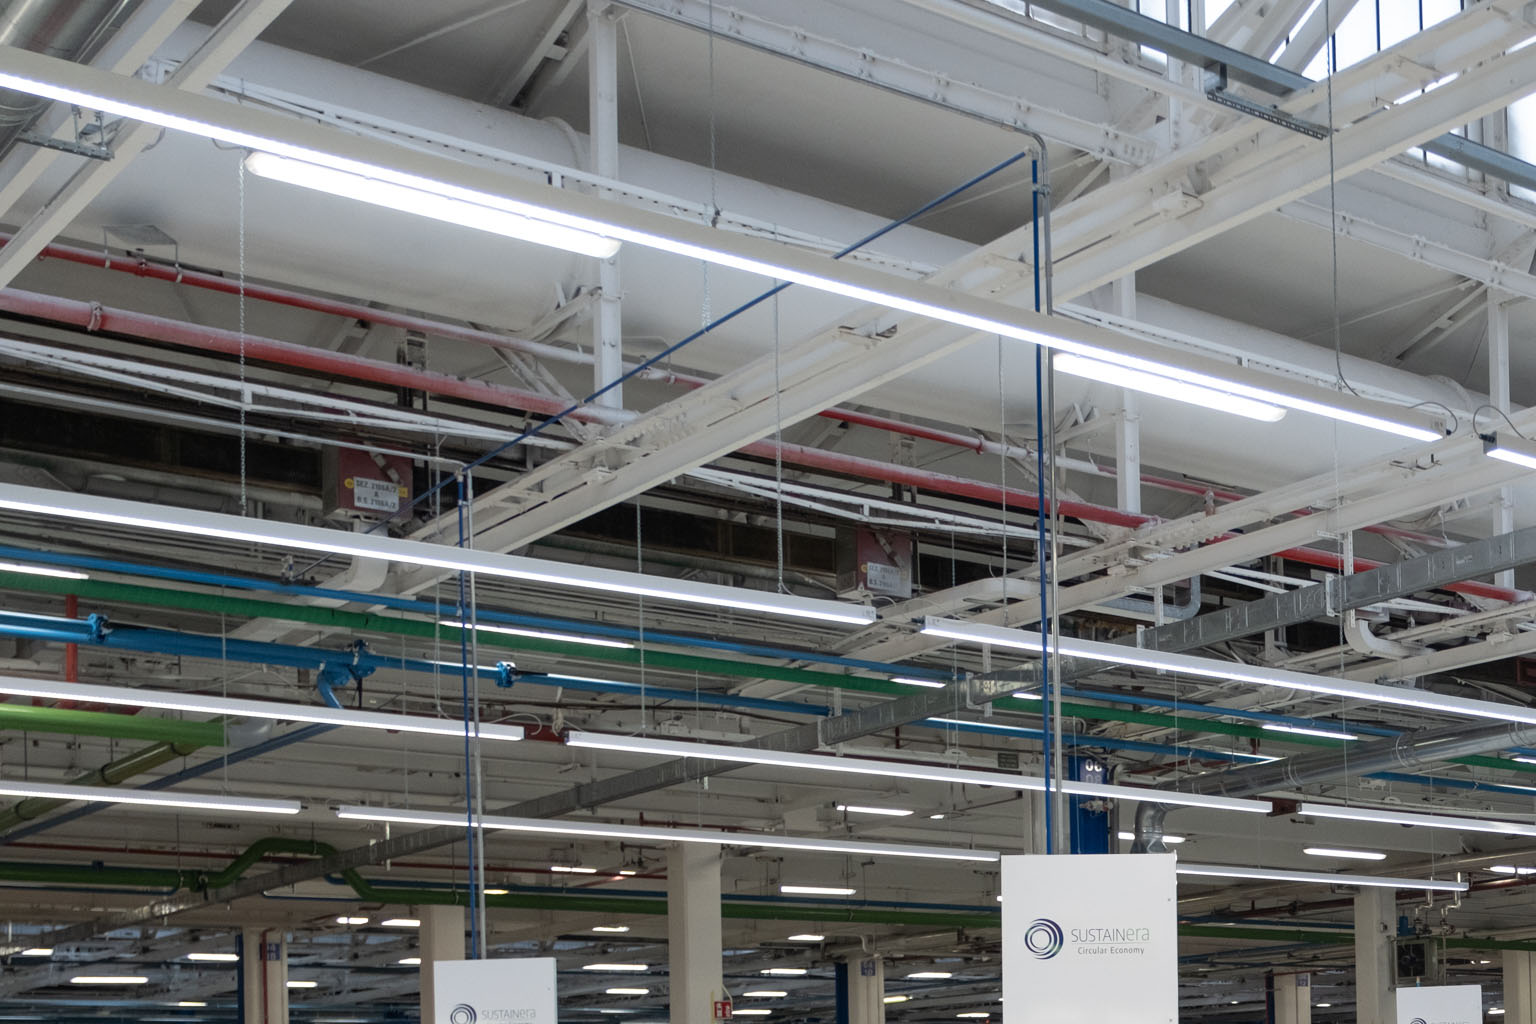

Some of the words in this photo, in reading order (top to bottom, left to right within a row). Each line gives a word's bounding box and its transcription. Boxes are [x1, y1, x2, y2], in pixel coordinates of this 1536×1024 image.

[1071, 927, 1150, 942] SUSTAINera
[1077, 946, 1107, 955] Circular
[1110, 946, 1145, 955] Economy
